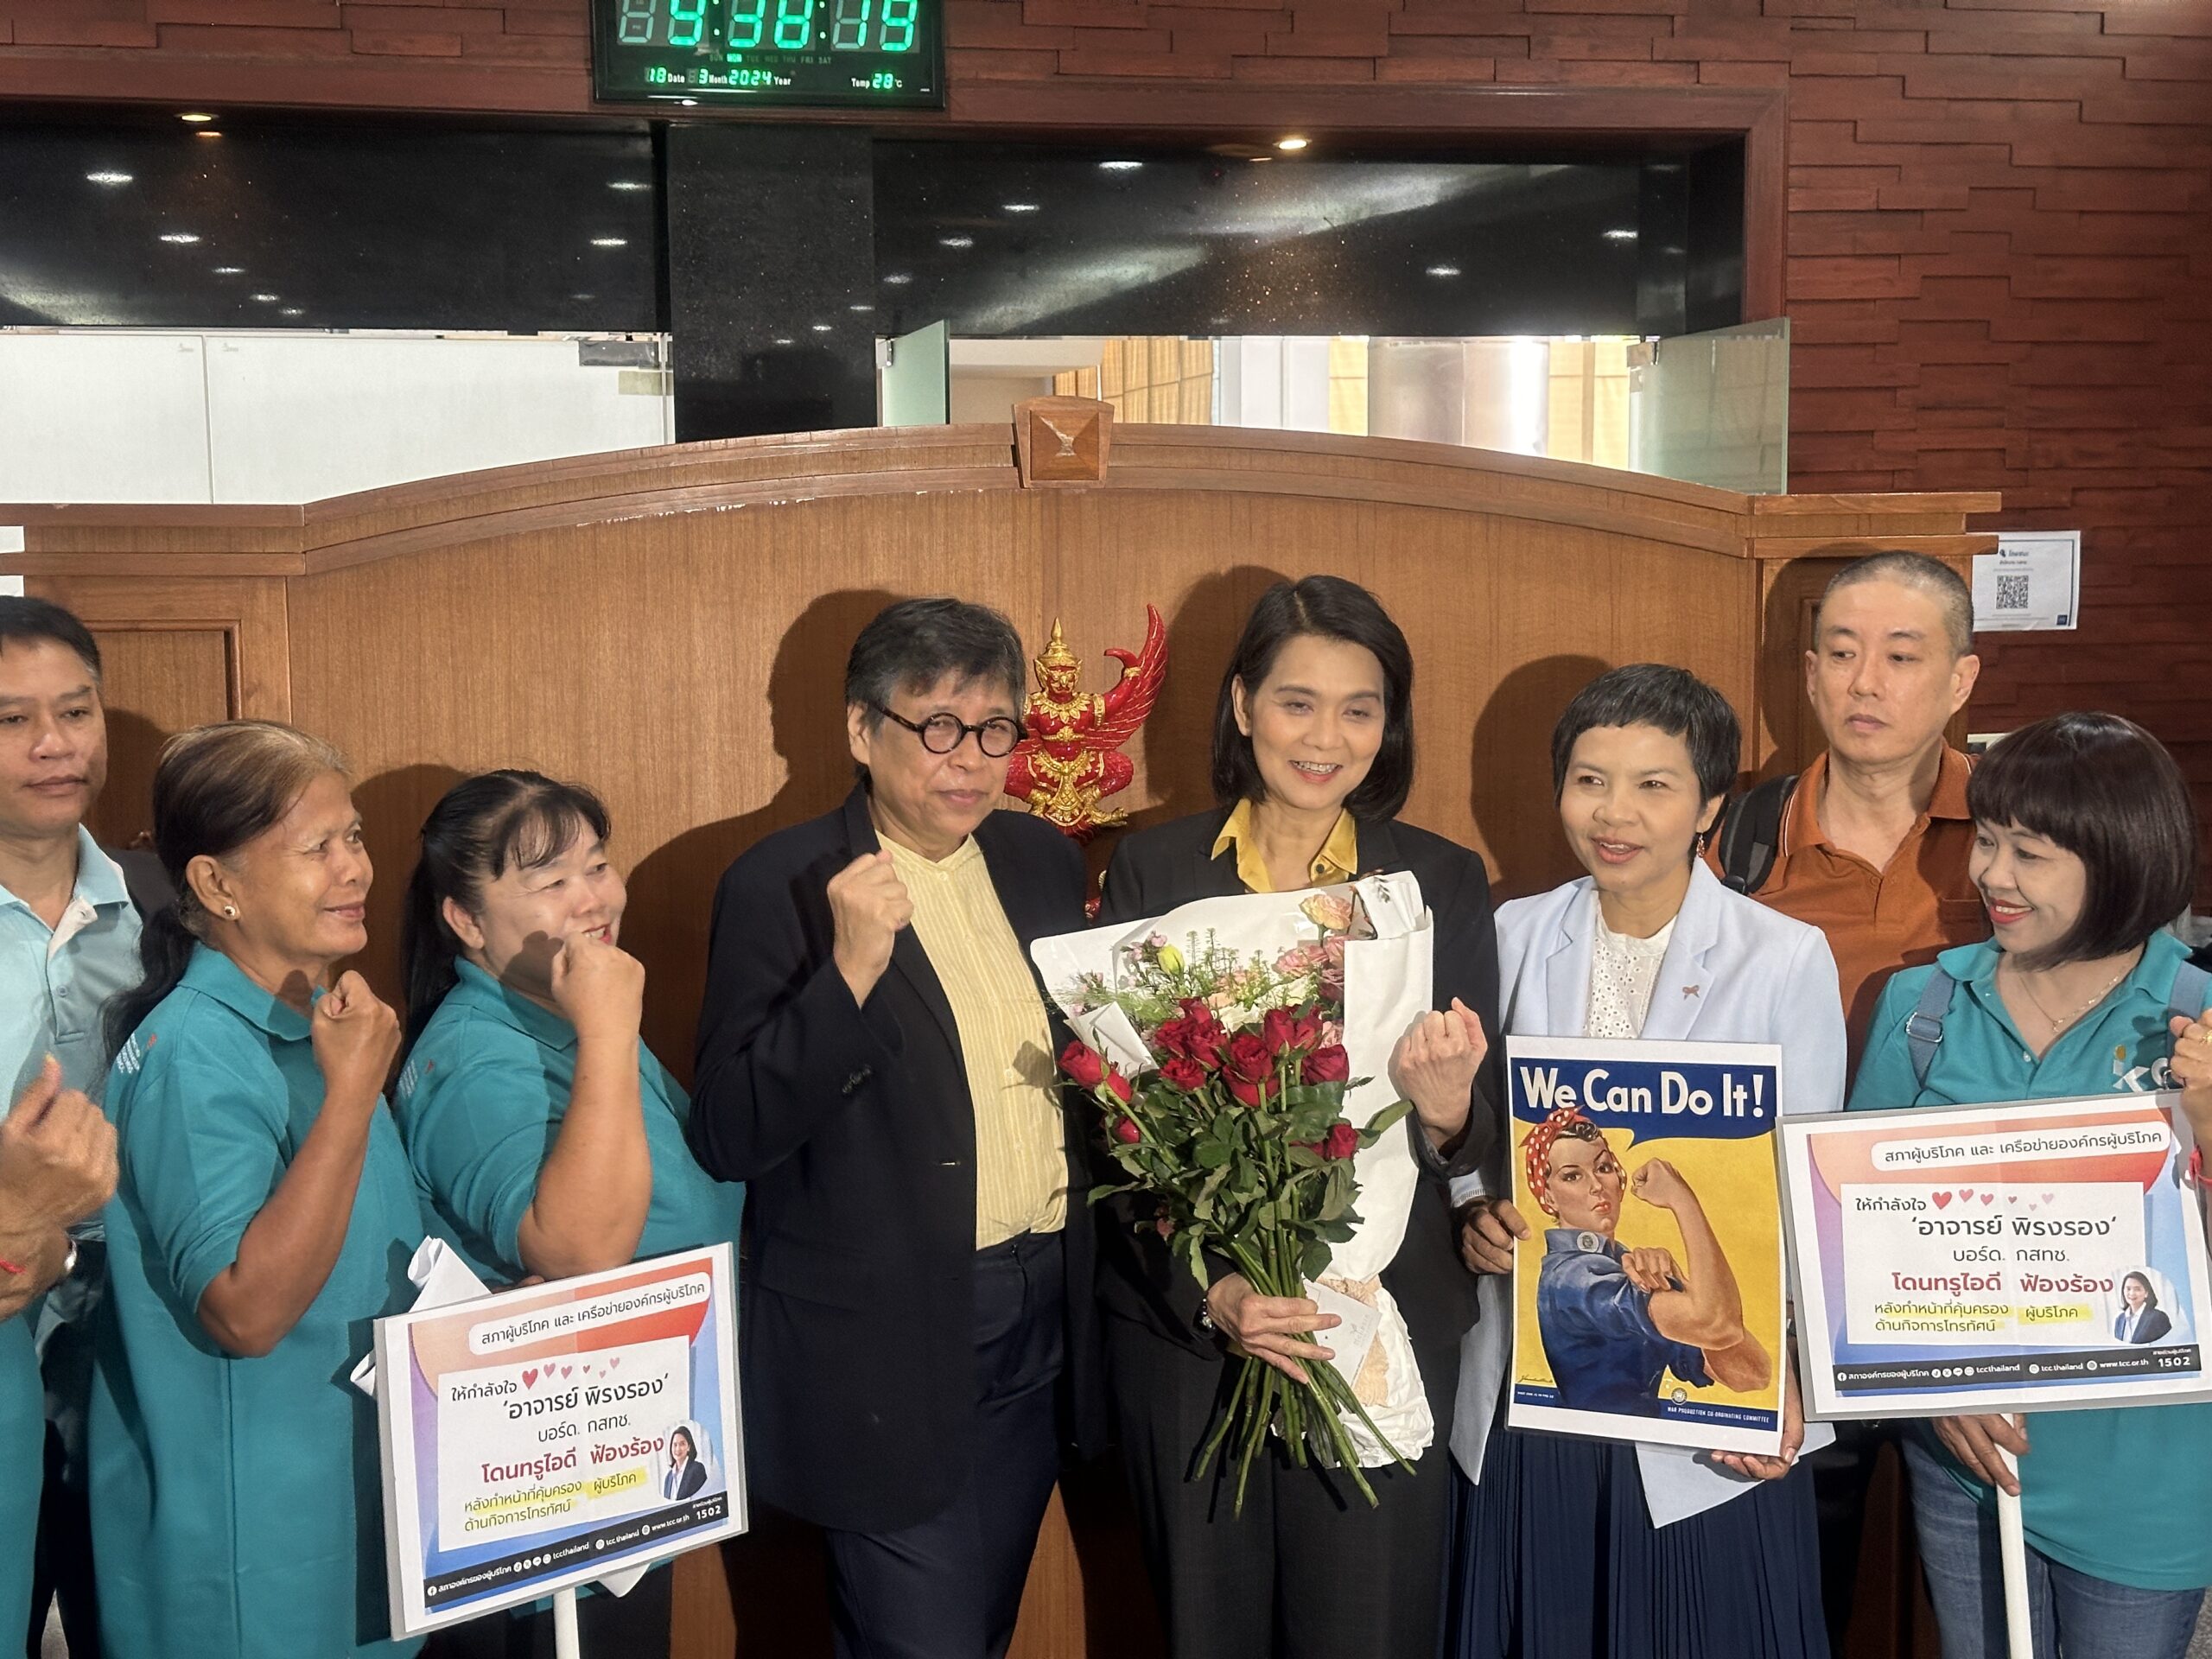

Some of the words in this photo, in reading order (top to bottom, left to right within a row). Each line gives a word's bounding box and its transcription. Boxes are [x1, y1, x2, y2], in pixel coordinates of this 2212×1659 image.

[668, 73, 685, 84] Date
[709, 73, 728, 85] Month
[728, 69, 772, 86] 2024
[773, 75, 791, 86] Year
[851, 77, 870, 89] Temp
[1520, 1066, 1577, 1109] We
[1583, 1068, 1652, 1113] Can
[1661, 1071, 1713, 1116] Do
[1722, 1072, 1764, 1118] It!
[1885, 1144, 1965, 1164] สภาผู้บริโภค
[1970, 1143, 1995, 1156] และ
[1999, 1128, 2162, 1154] เครือข่ายองค์กรผู้บริโภค
[1855, 1197, 1927, 1211] ให้กำลังใจ
[1953, 1245, 2006, 1263] บอร์ด.
[2016, 1247, 2070, 1262] กสทช.
[1891, 1271, 2002, 1296] โดนทรูไอดี
[2019, 1273, 2114, 1294] ฟ้องร้อง
[481, 1318, 550, 1345] สภาผู้บริโภค
[553, 1313, 575, 1327] และ
[577, 1281, 706, 1323] เครือข่ายองค์กรผู้บริโภค
[1873, 1298, 2010, 1319] หลังทำหน้าที่คุ้มครอง
[2024, 1305, 2079, 1322] ผู้บริโภค
[1874, 1317, 1996, 1333] ด้านกิจการโทรทัศน์
[1976, 1363, 2020, 1375] tccthailand
[2158, 1356, 2191, 1368] 1502
[451, 1379, 518, 1403] ให้กำลังใจ
[537, 1421, 581, 1443] บอร์ด.
[588, 1414, 631, 1434] กสทช.
[1742, 1414, 1770, 1424] COMMITTEE
[481, 1446, 578, 1484] โดนทรูไอดี
[589, 1435, 665, 1466] ฟ้องร้อง
[464, 1478, 583, 1513] หลังทำหน้าที่คุ้มครอง
[593, 1471, 638, 1495] ผู้บริโภค
[464, 1497, 572, 1533] ด้านกิจการโทรทัศน์
[696, 1504, 722, 1522] 1502
